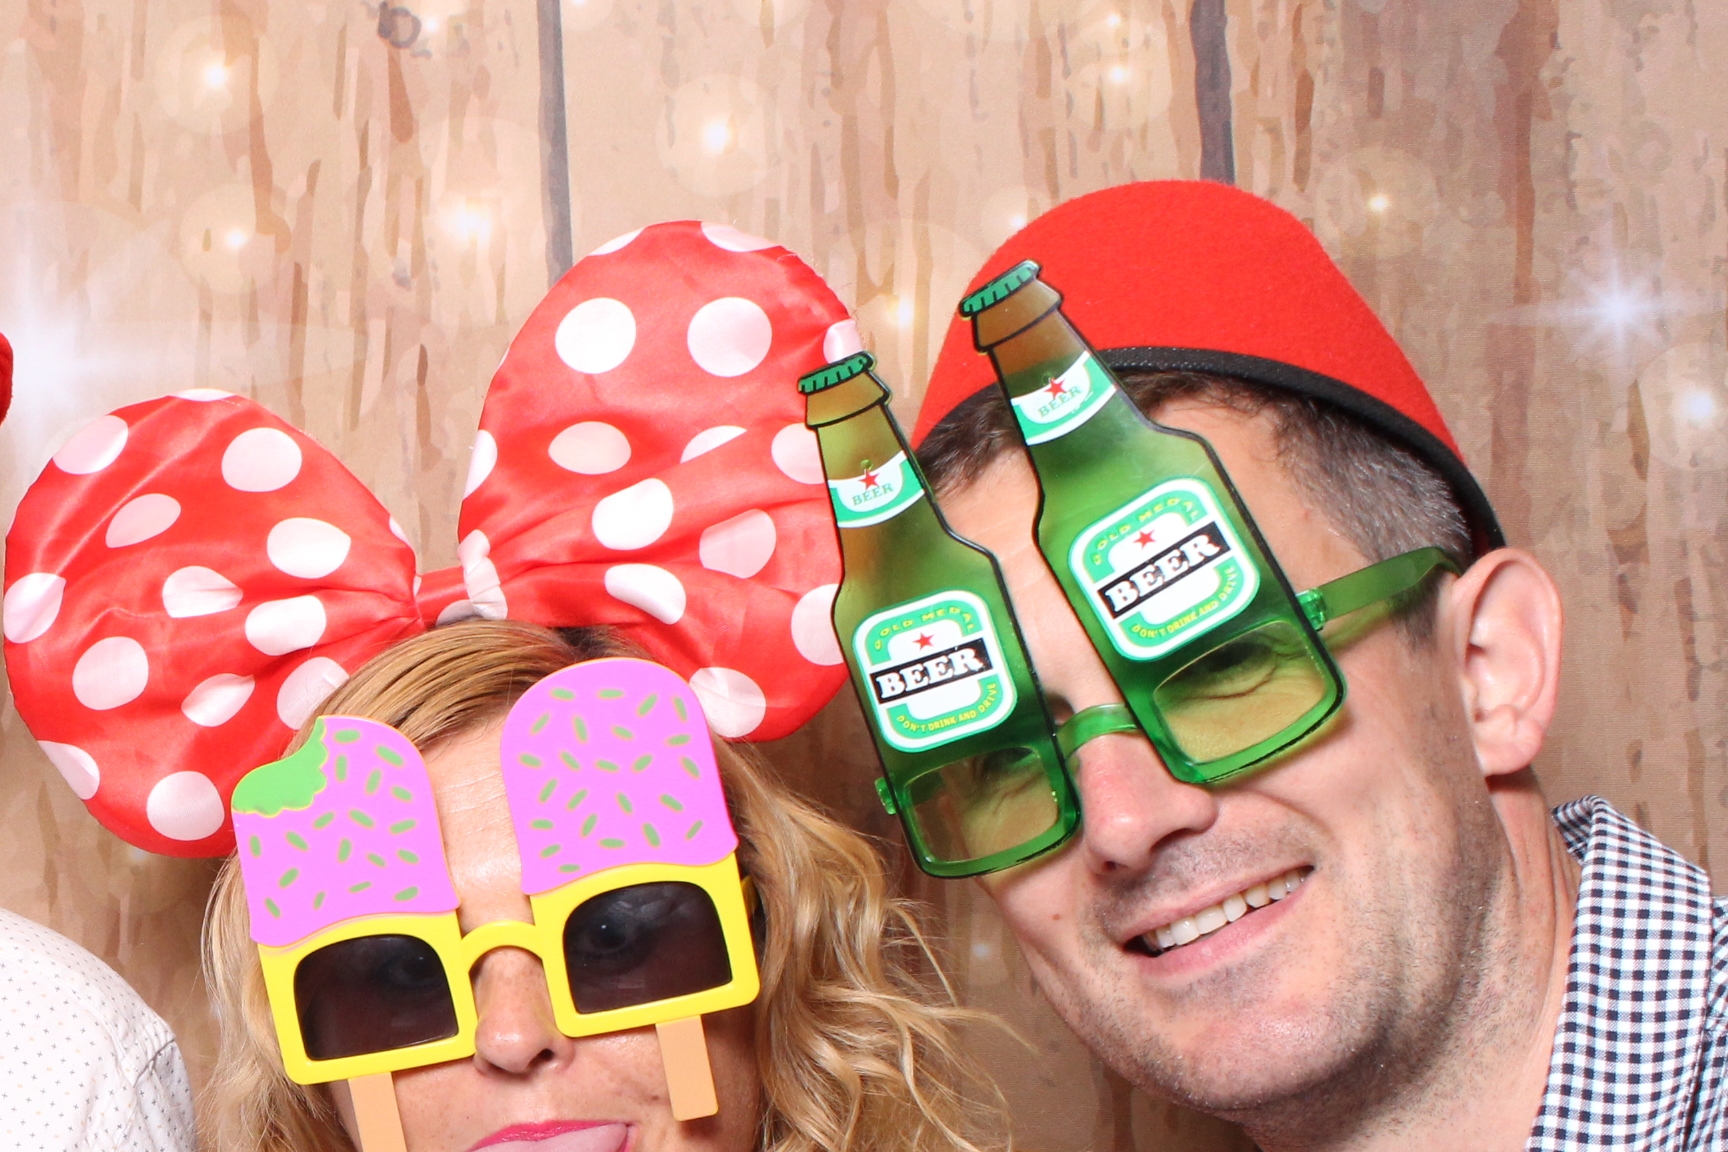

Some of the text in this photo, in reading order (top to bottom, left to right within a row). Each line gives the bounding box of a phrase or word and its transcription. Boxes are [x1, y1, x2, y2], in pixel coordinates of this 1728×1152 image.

[1037, 385, 1082, 418] BEER
[852, 483, 894, 506] BEER
[1092, 497, 1200, 566] GOLD MEDAL
[1104, 533, 1221, 613] BEER
[874, 606, 975, 651] GOLD MEDAL
[875, 647, 985, 699] BEER
[897, 682, 998, 733] DON'T DRINK AND DRIVE
